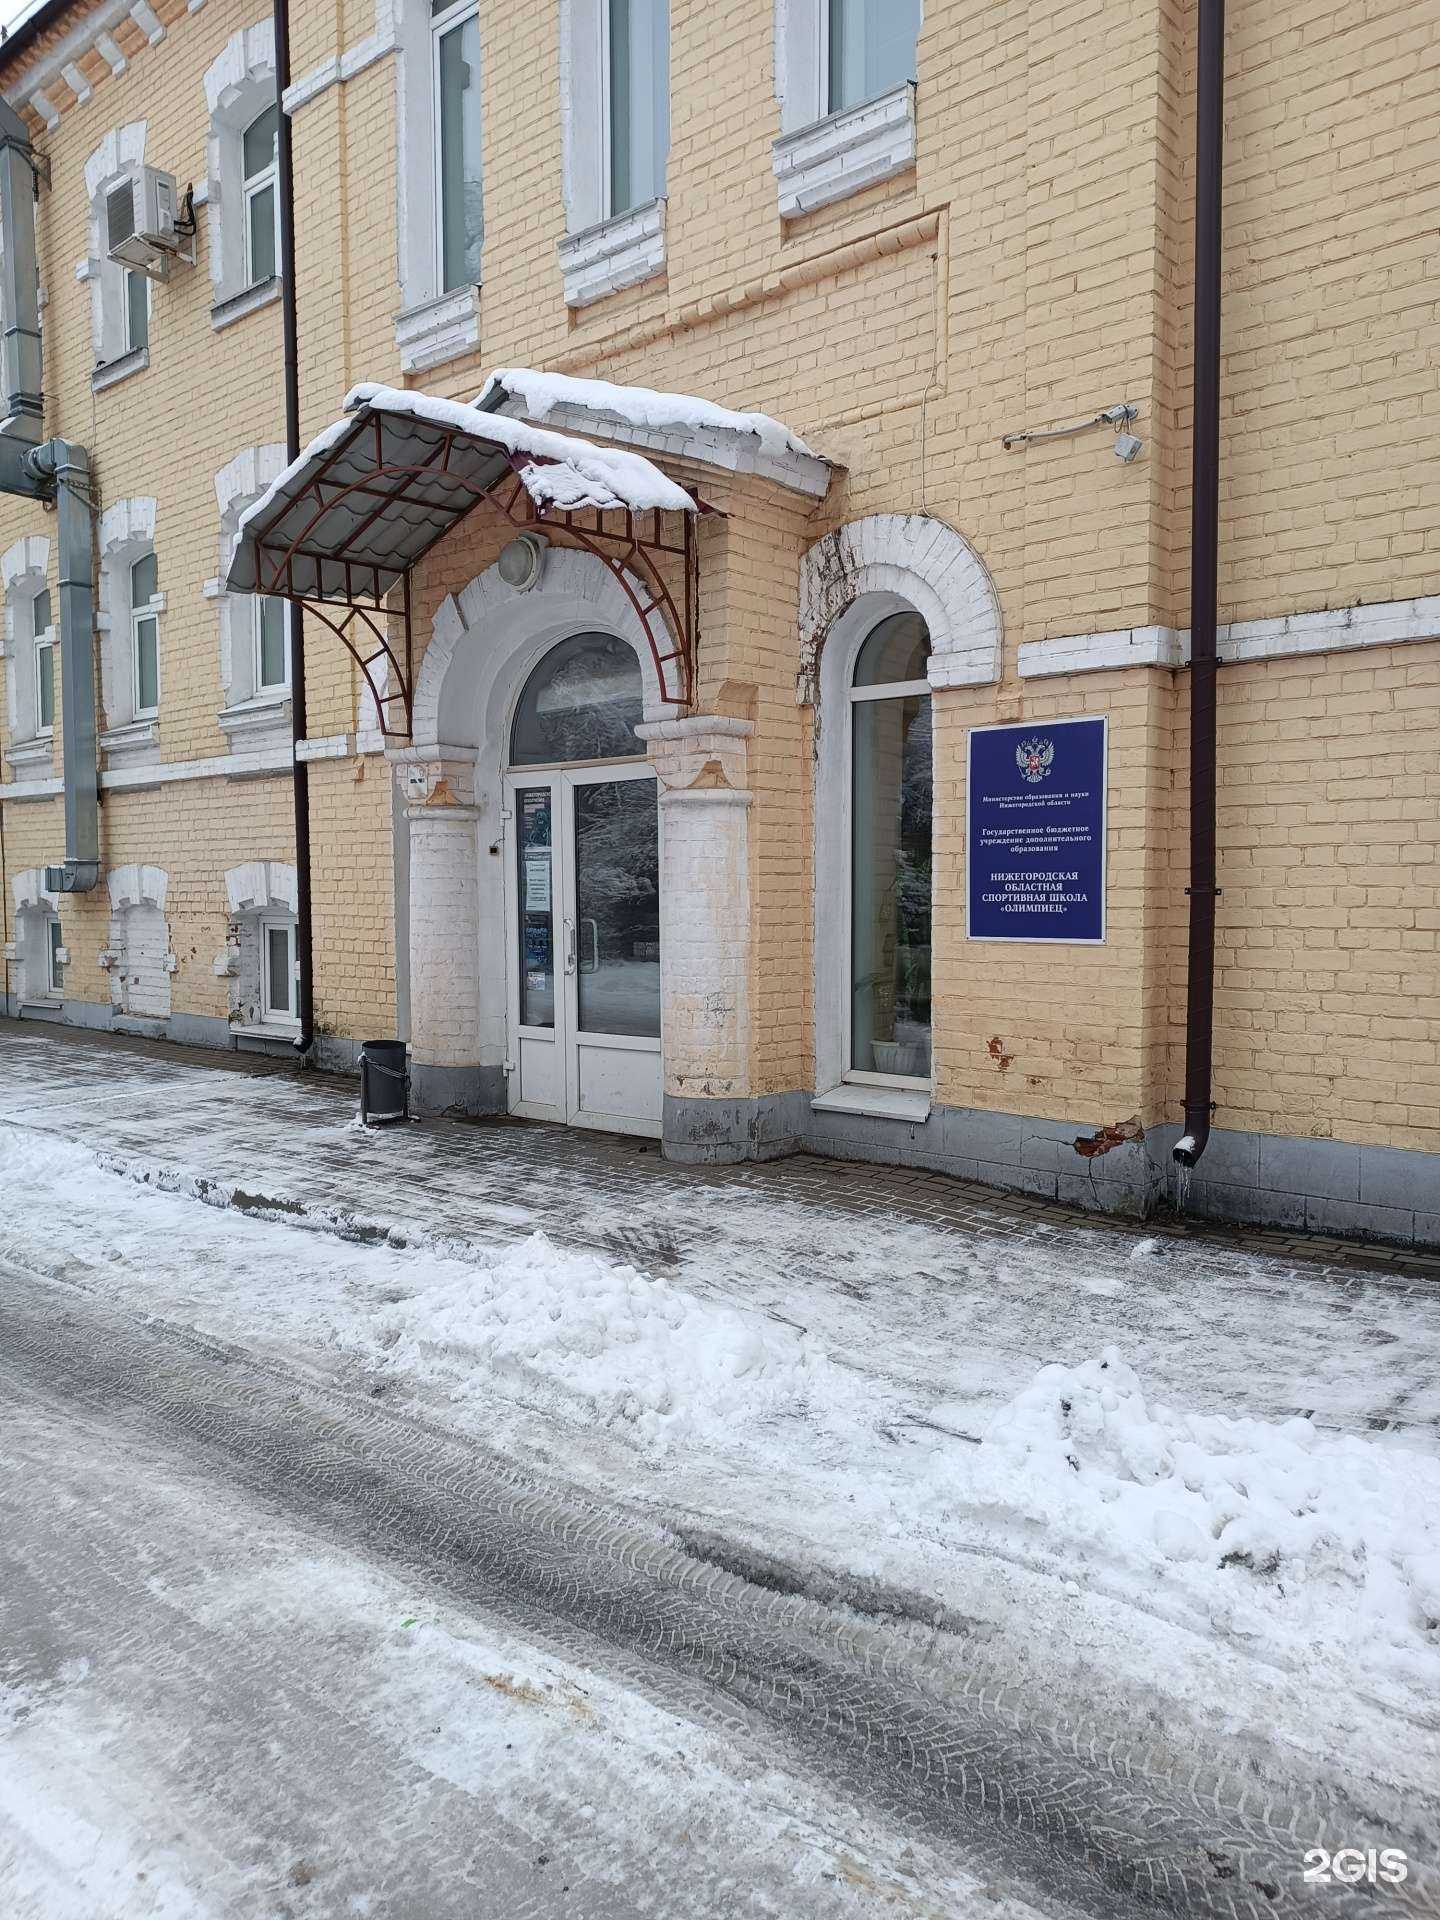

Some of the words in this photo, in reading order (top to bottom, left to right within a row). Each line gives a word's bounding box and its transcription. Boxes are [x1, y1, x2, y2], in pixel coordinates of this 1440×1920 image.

[982, 828, 1044, 837] Государственное
[1046, 826, 1089, 834] бюджетное
[979, 837, 1024, 846] учреждение
[1025, 835, 1092, 844] дополнительного
[1010, 845, 1059, 854] образования
[990, 871, 1079, 882] НИЖЕГОРОДСКАЯ
[1004, 882, 1063, 892] ОБЛАСТНАЯ
[981, 893, 1046, 902] СПОРТИВНАЯ
[1049, 893, 1088, 902] ШКОЛА
[1000, 903, 1068, 914] «ОЛИМПИЕЦ»
